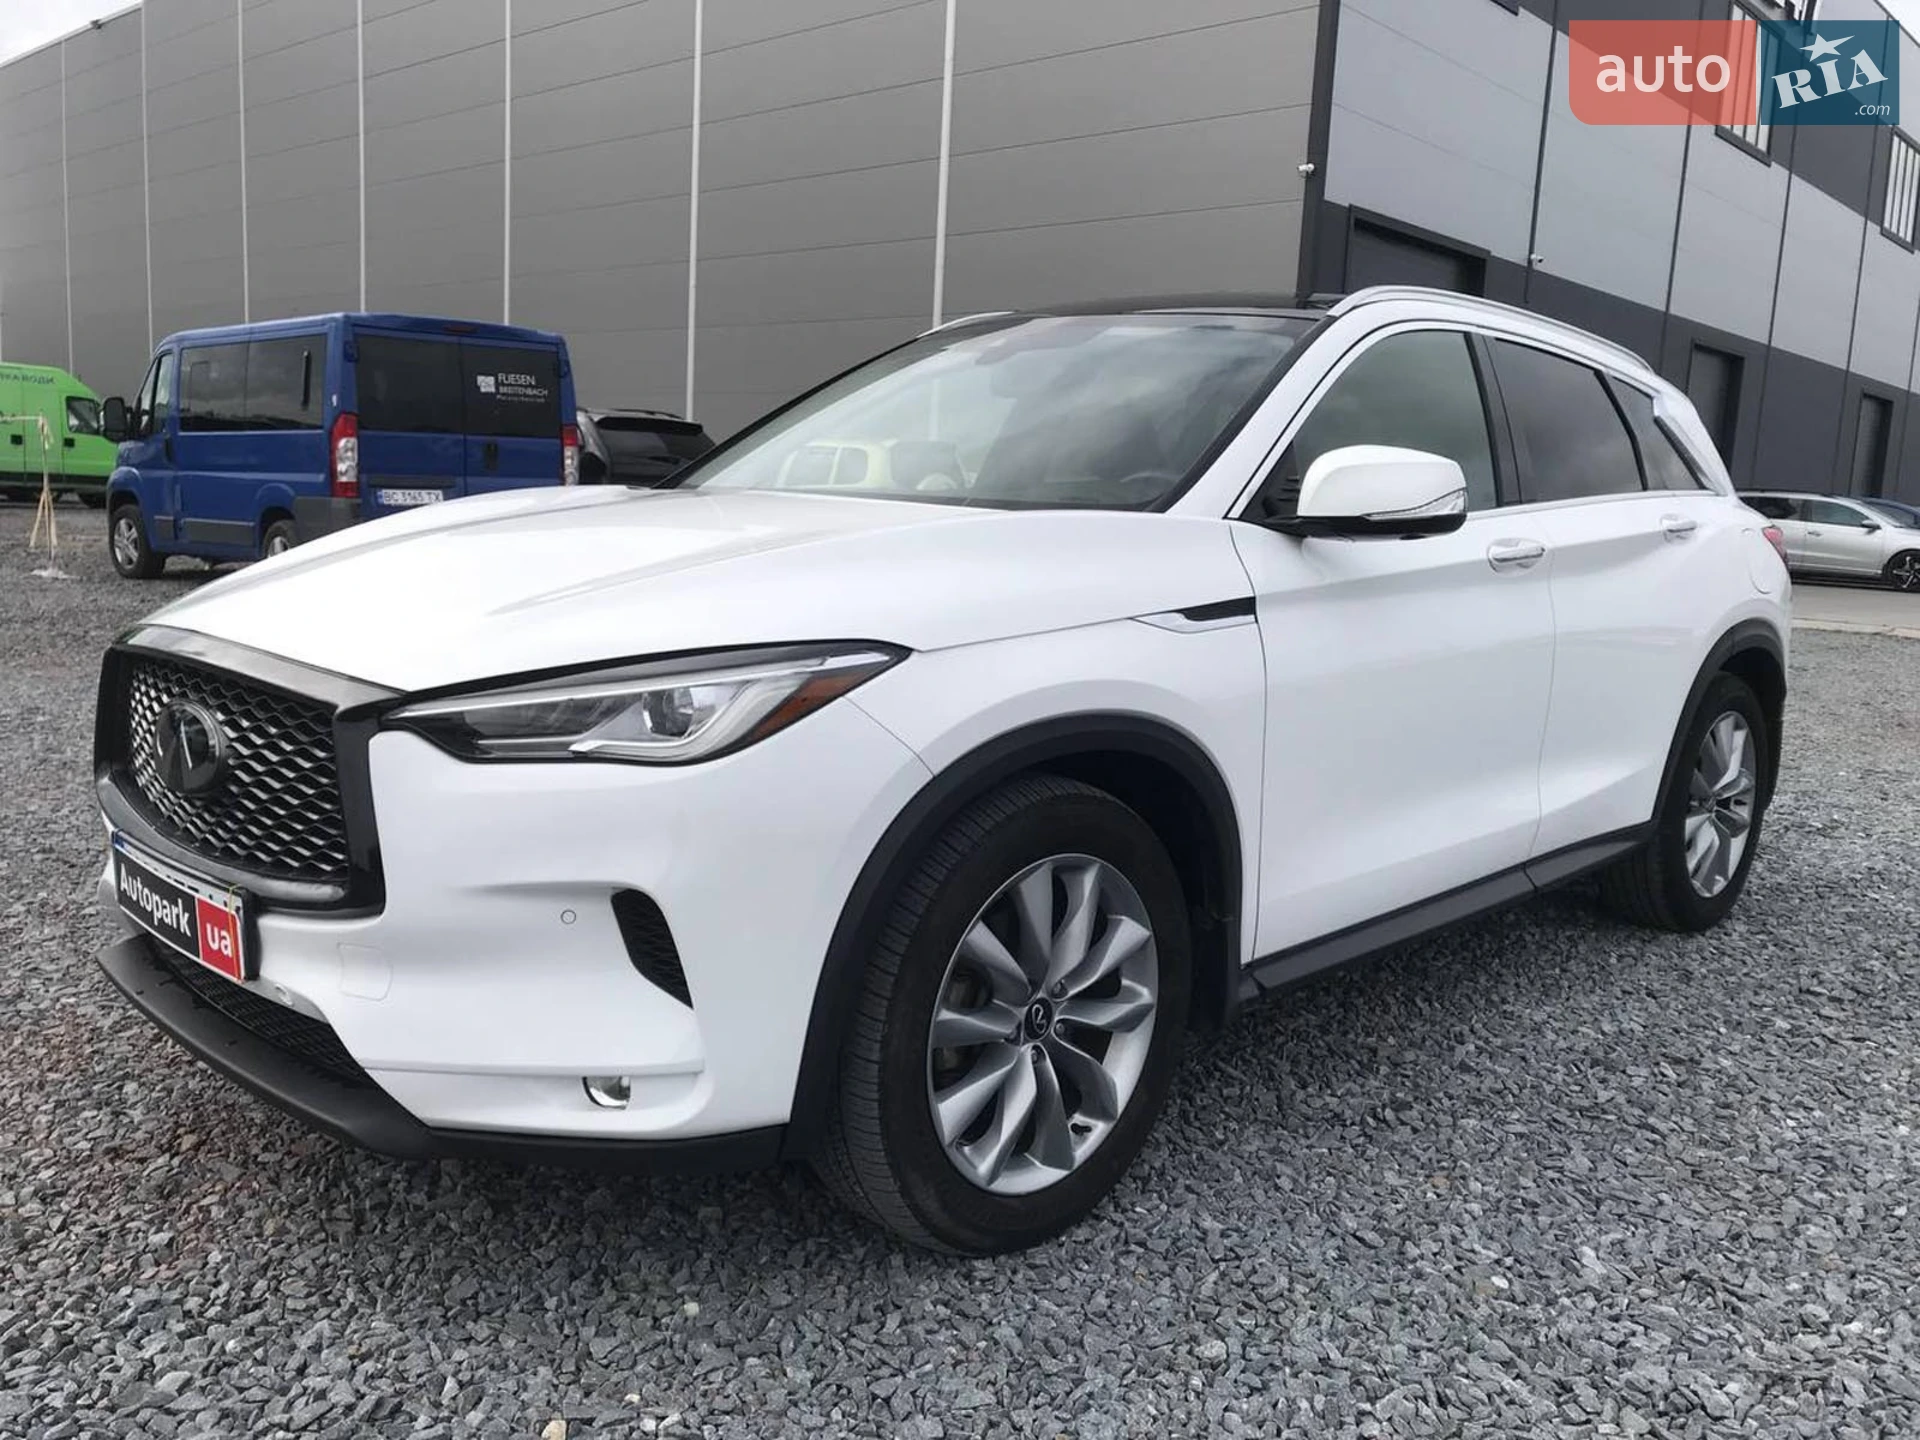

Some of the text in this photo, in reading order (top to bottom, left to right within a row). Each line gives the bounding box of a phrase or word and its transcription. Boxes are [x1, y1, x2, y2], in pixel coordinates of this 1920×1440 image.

[498, 373, 536, 385] FLIESEN
[120, 863, 233, 958] Autopark ua
